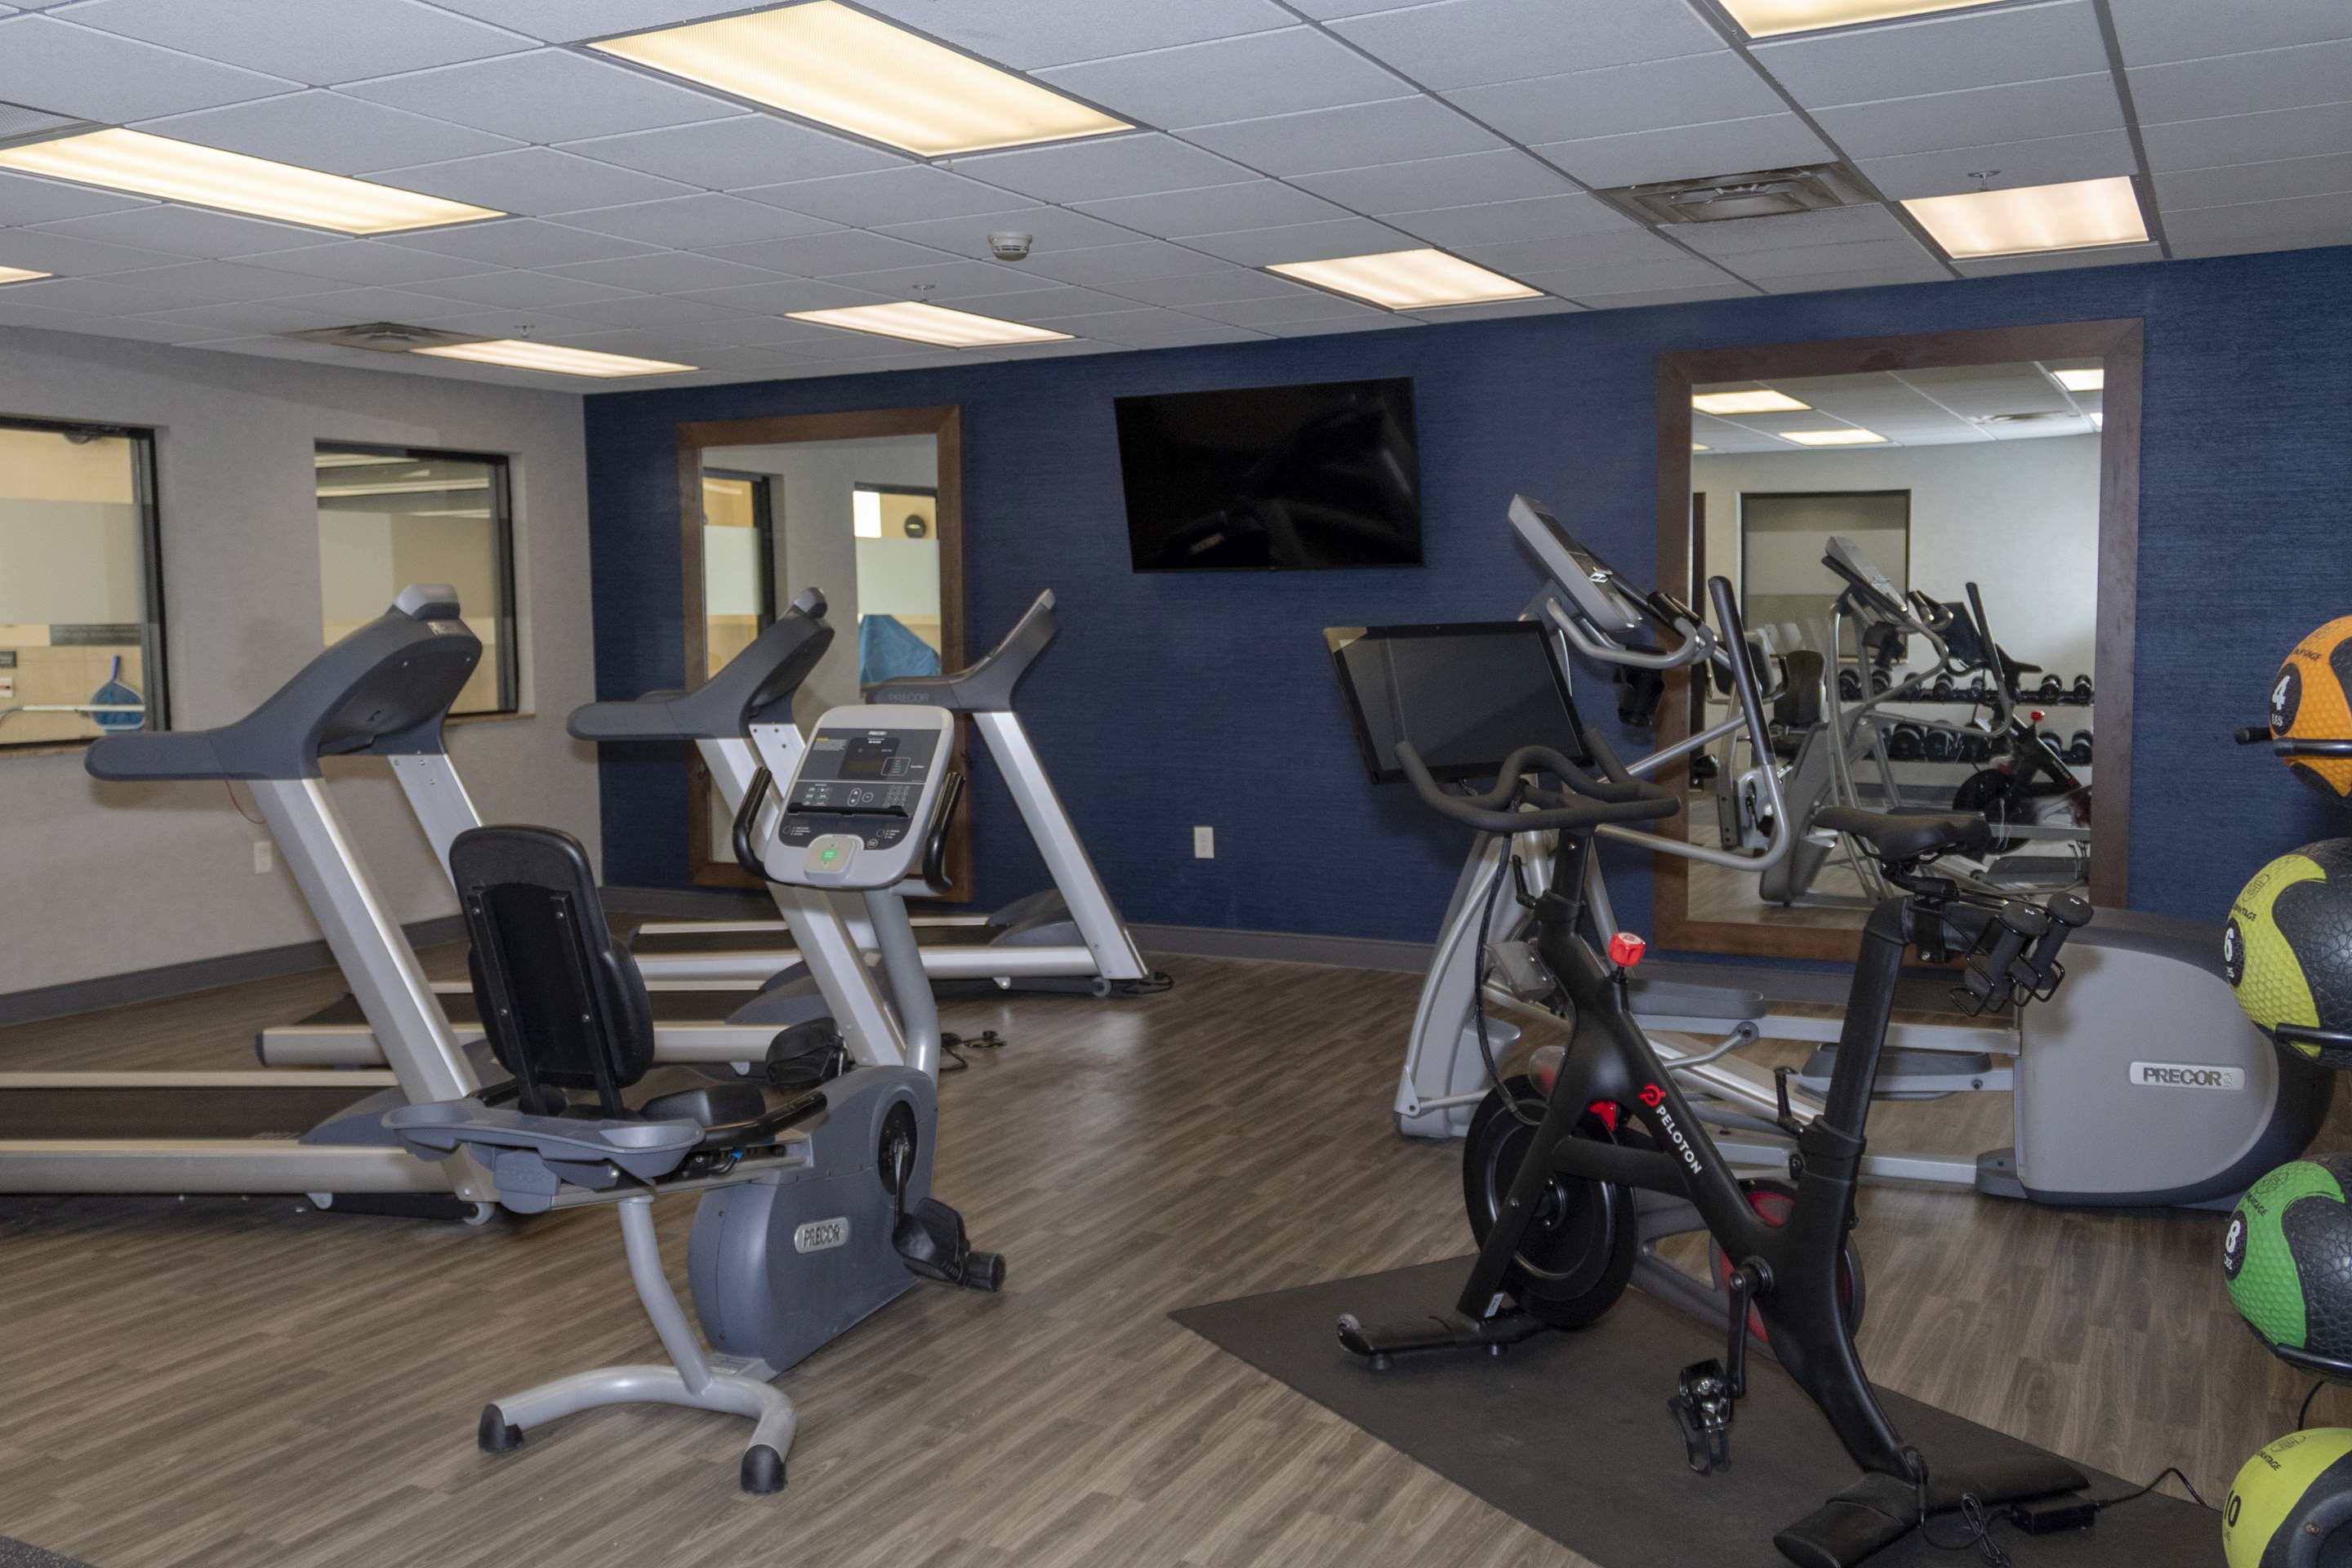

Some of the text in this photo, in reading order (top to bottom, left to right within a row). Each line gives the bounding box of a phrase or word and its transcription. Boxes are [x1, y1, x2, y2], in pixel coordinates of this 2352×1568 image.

[2272, 675, 2291, 710] 4
[2224, 928, 2234, 961] 6
[2143, 1067, 2221, 1086] PRECOR
[1656, 1104, 1703, 1174] PELOTON
[2225, 1220, 2241, 1254] 8
[2224, 1490, 2241, 1528] 10
